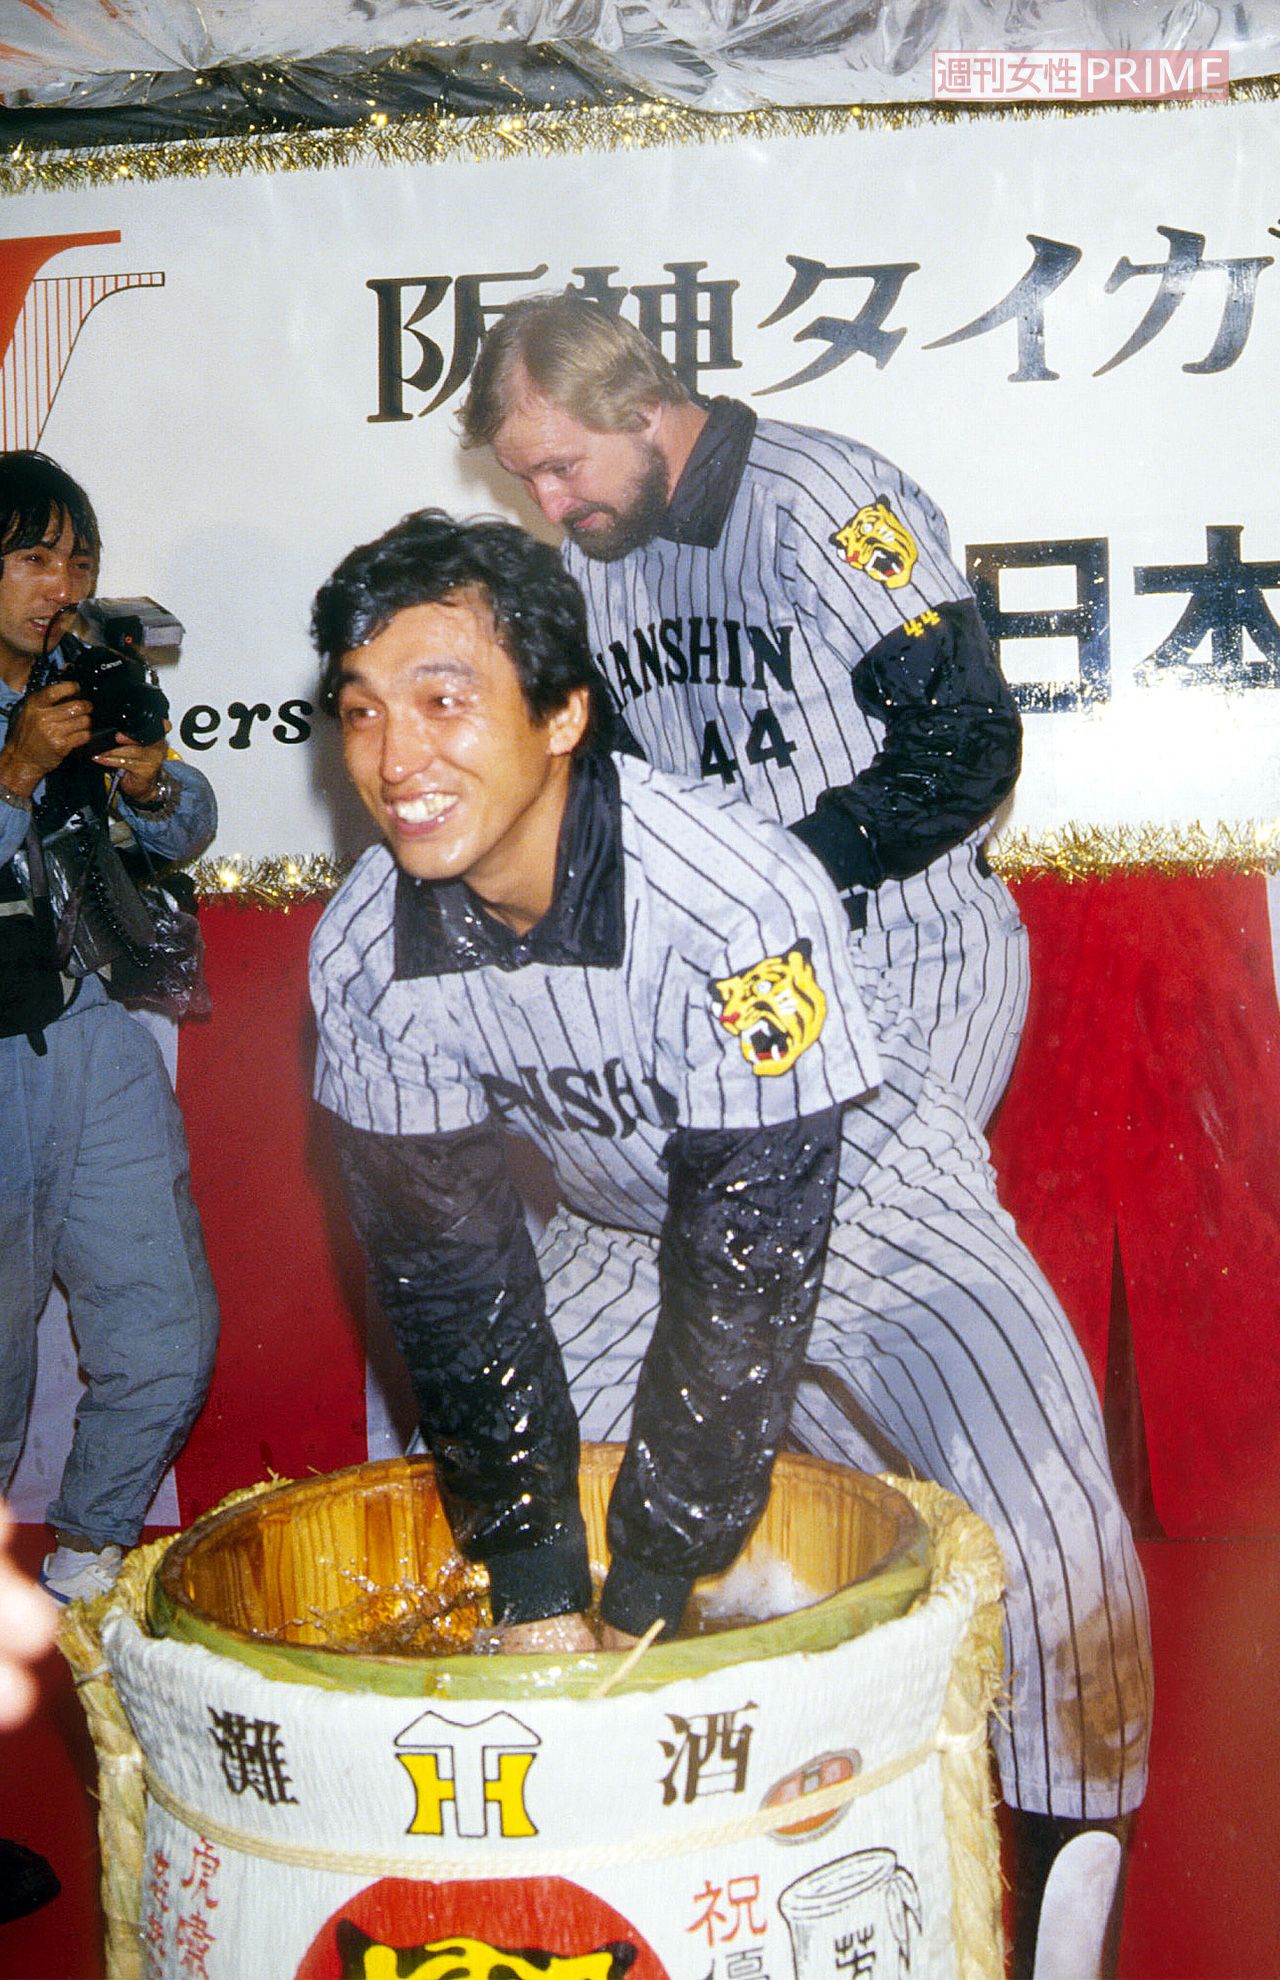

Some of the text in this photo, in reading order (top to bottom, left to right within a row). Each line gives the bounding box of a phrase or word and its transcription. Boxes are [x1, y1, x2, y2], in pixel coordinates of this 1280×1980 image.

[903, 609, 941, 638] 44
[180, 699, 314, 751] ers
[700, 706, 798, 785] 44
[656, 1699, 759, 1806] 酒
